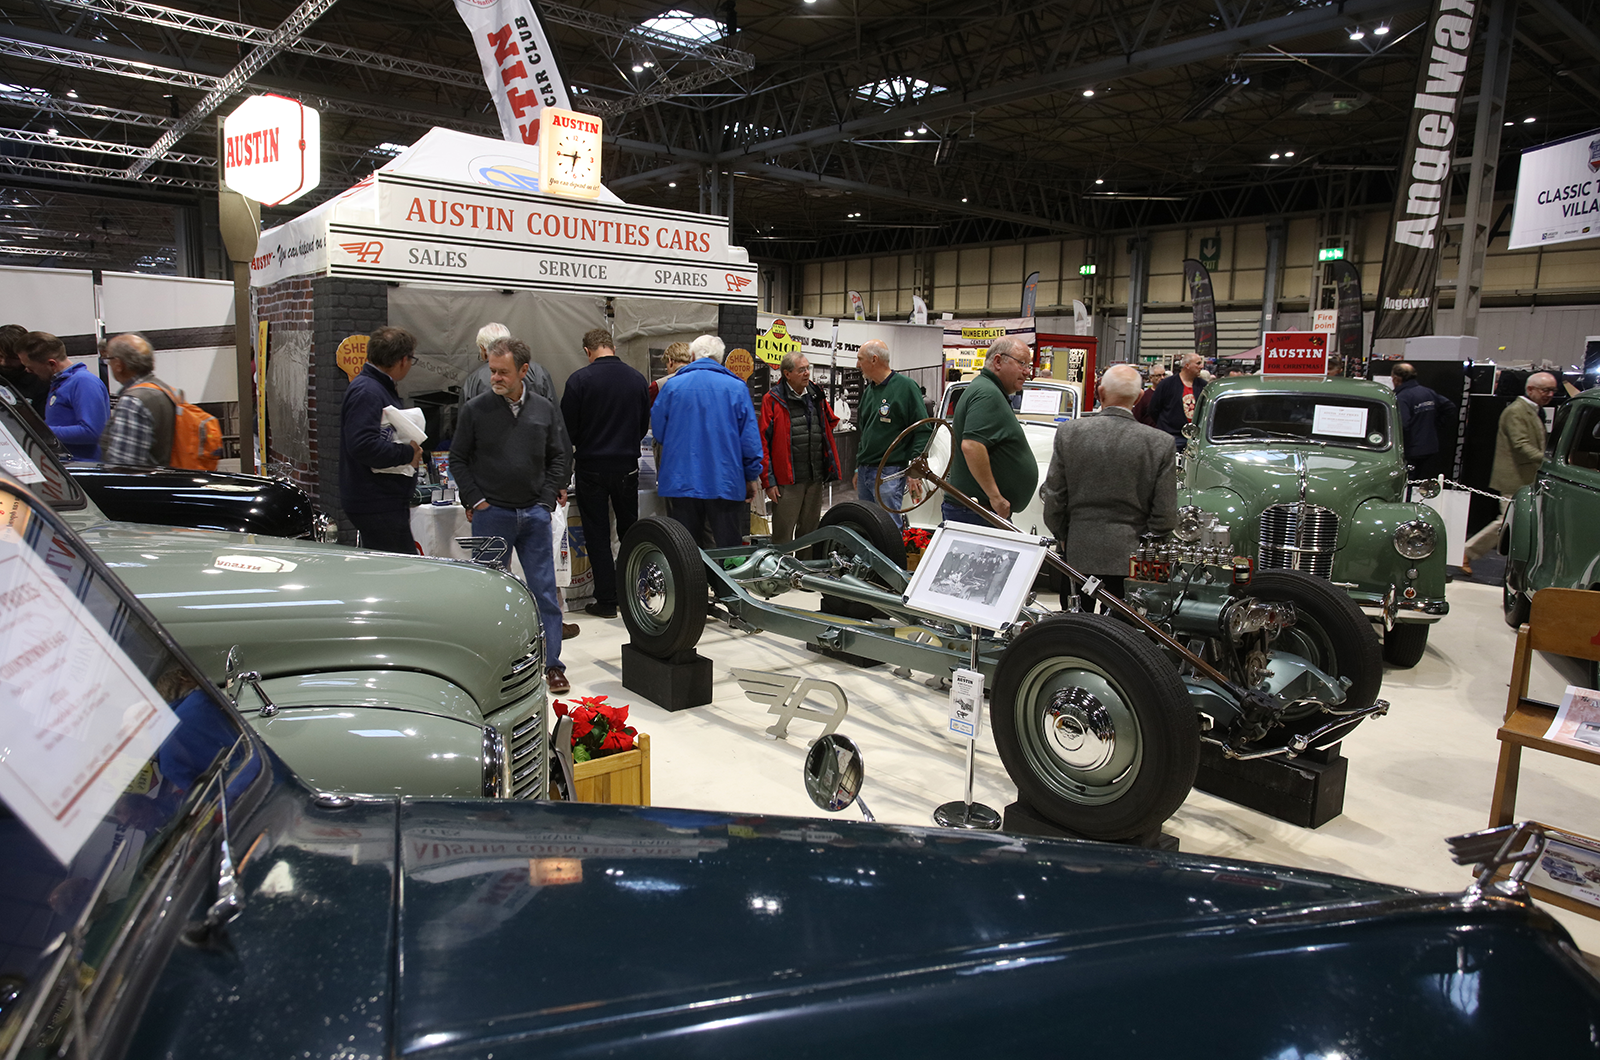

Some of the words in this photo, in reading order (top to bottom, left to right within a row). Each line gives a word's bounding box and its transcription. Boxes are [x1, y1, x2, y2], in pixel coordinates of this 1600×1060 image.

[514, 15, 542, 65] CLUB
[535, 69, 557, 107] CAR
[552, 114, 600, 135] AUSTIN
[226, 127, 280, 168] AUSTIN
[1537, 181, 1592, 206] CLASSIC
[405, 196, 515, 233] AUSTIN
[526, 211, 650, 247] COUNTIES
[655, 226, 711, 253] CARS
[408, 246, 468, 269] SALES
[538, 259, 608, 280] SERVICE
[654, 269, 708, 288] SPARES
[1314, 322, 1335, 330] point
[1317, 313, 1333, 321] Fire
[963, 329, 1005, 338] NUMBERPLATE
[729, 354, 750, 365] SHELL
[1268, 347, 1324, 358] AUSTIN
[729, 364, 751, 373] MOTOR
